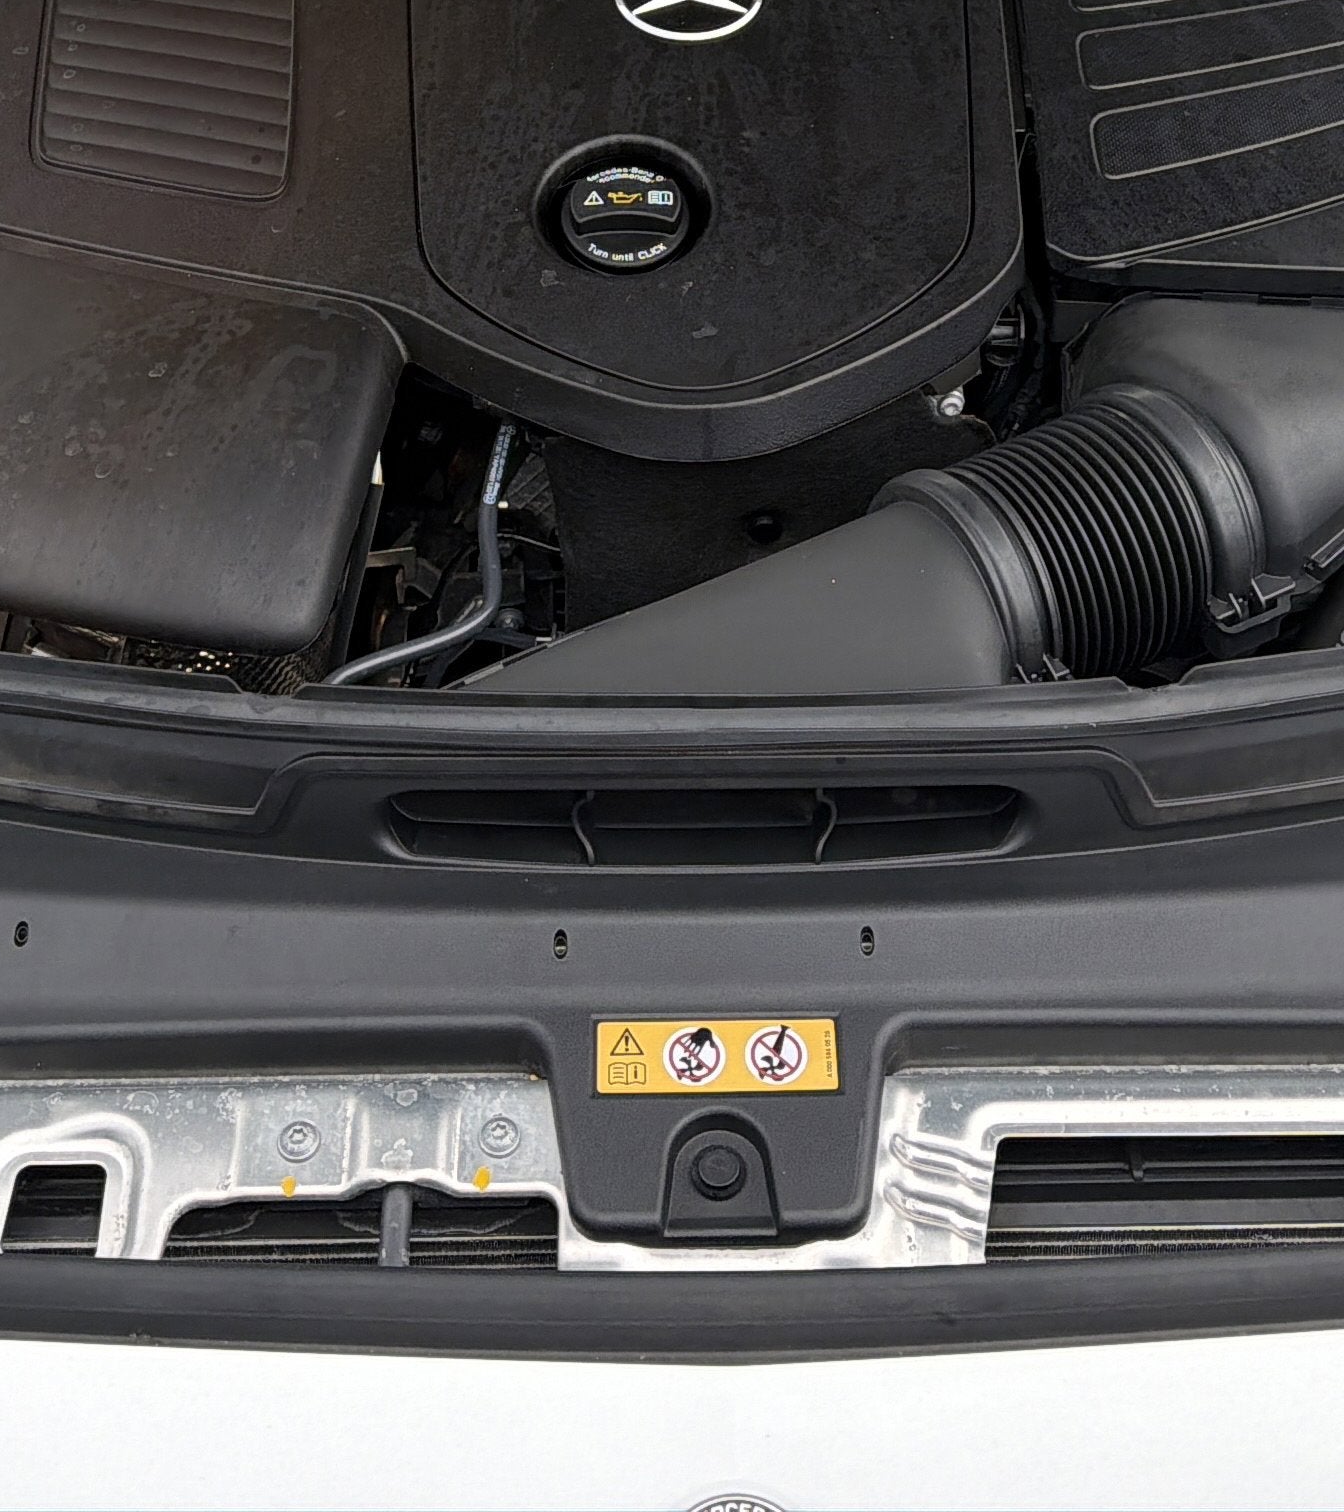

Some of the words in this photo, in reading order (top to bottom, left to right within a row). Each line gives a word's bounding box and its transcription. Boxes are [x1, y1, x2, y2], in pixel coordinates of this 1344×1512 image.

[588, 243, 609, 259] Turn
[611, 252, 635, 262] until
[637, 242, 668, 260] CLICK
